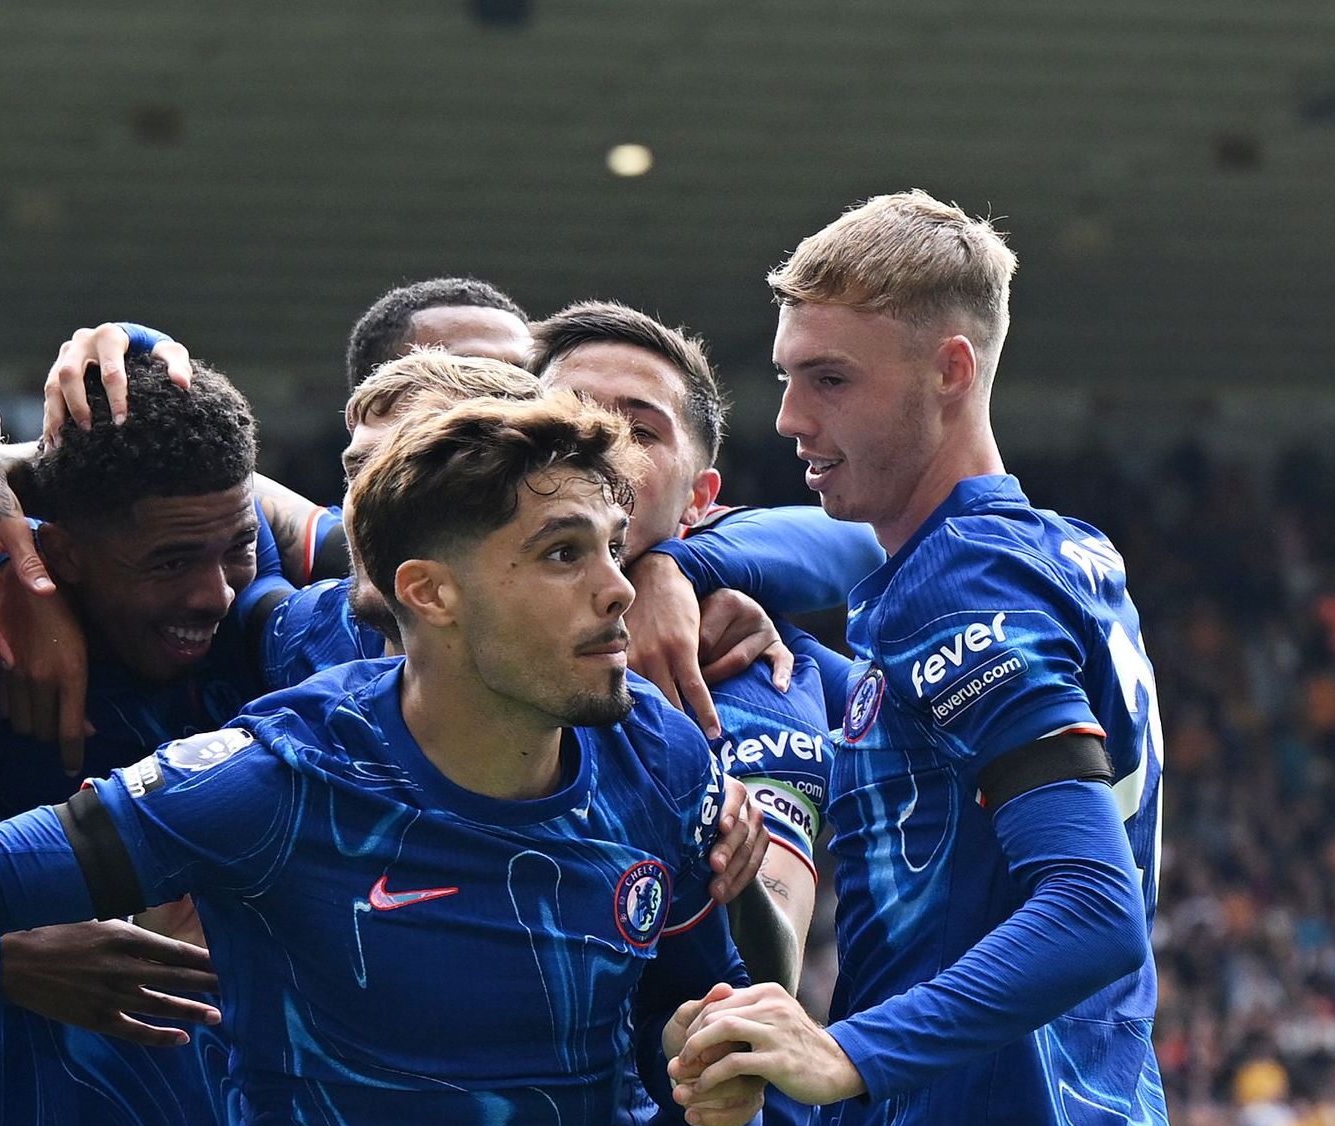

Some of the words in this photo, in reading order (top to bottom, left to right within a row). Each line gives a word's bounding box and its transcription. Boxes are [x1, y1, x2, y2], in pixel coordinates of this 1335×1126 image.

[911, 611, 1007, 699] fever
[931, 656, 1023, 720] feverup.com
[720, 730, 825, 773] fever
